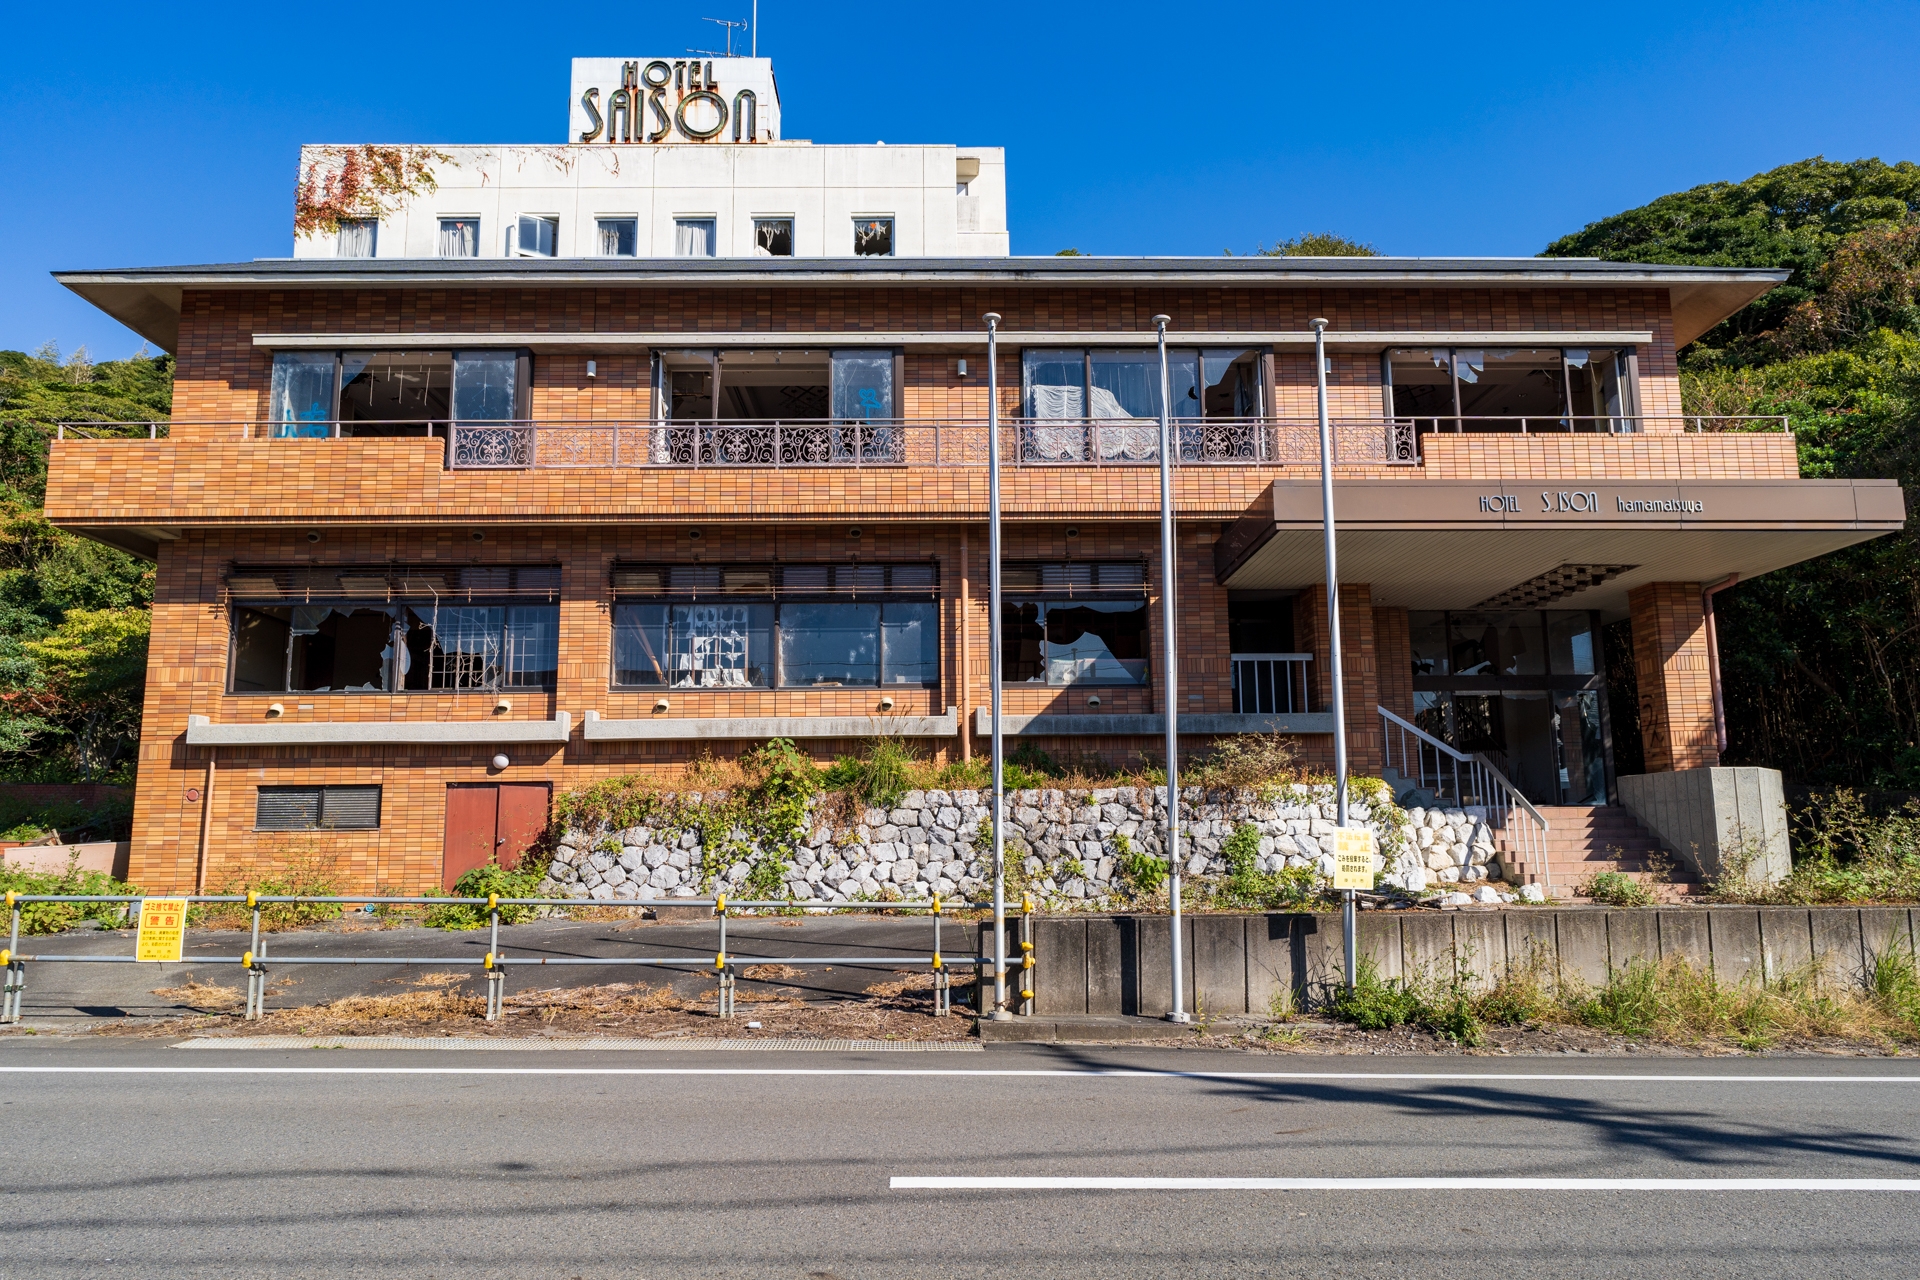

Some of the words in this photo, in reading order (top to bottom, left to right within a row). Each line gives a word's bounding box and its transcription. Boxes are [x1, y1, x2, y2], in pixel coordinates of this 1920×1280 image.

[623, 61, 718, 87] HOTEL
[582, 87, 757, 140] SAISON
[1479, 495, 1522, 512] HOTEL
[1541, 491, 1599, 512] SISON
[1617, 495, 1704, 514] hamamatsuya
